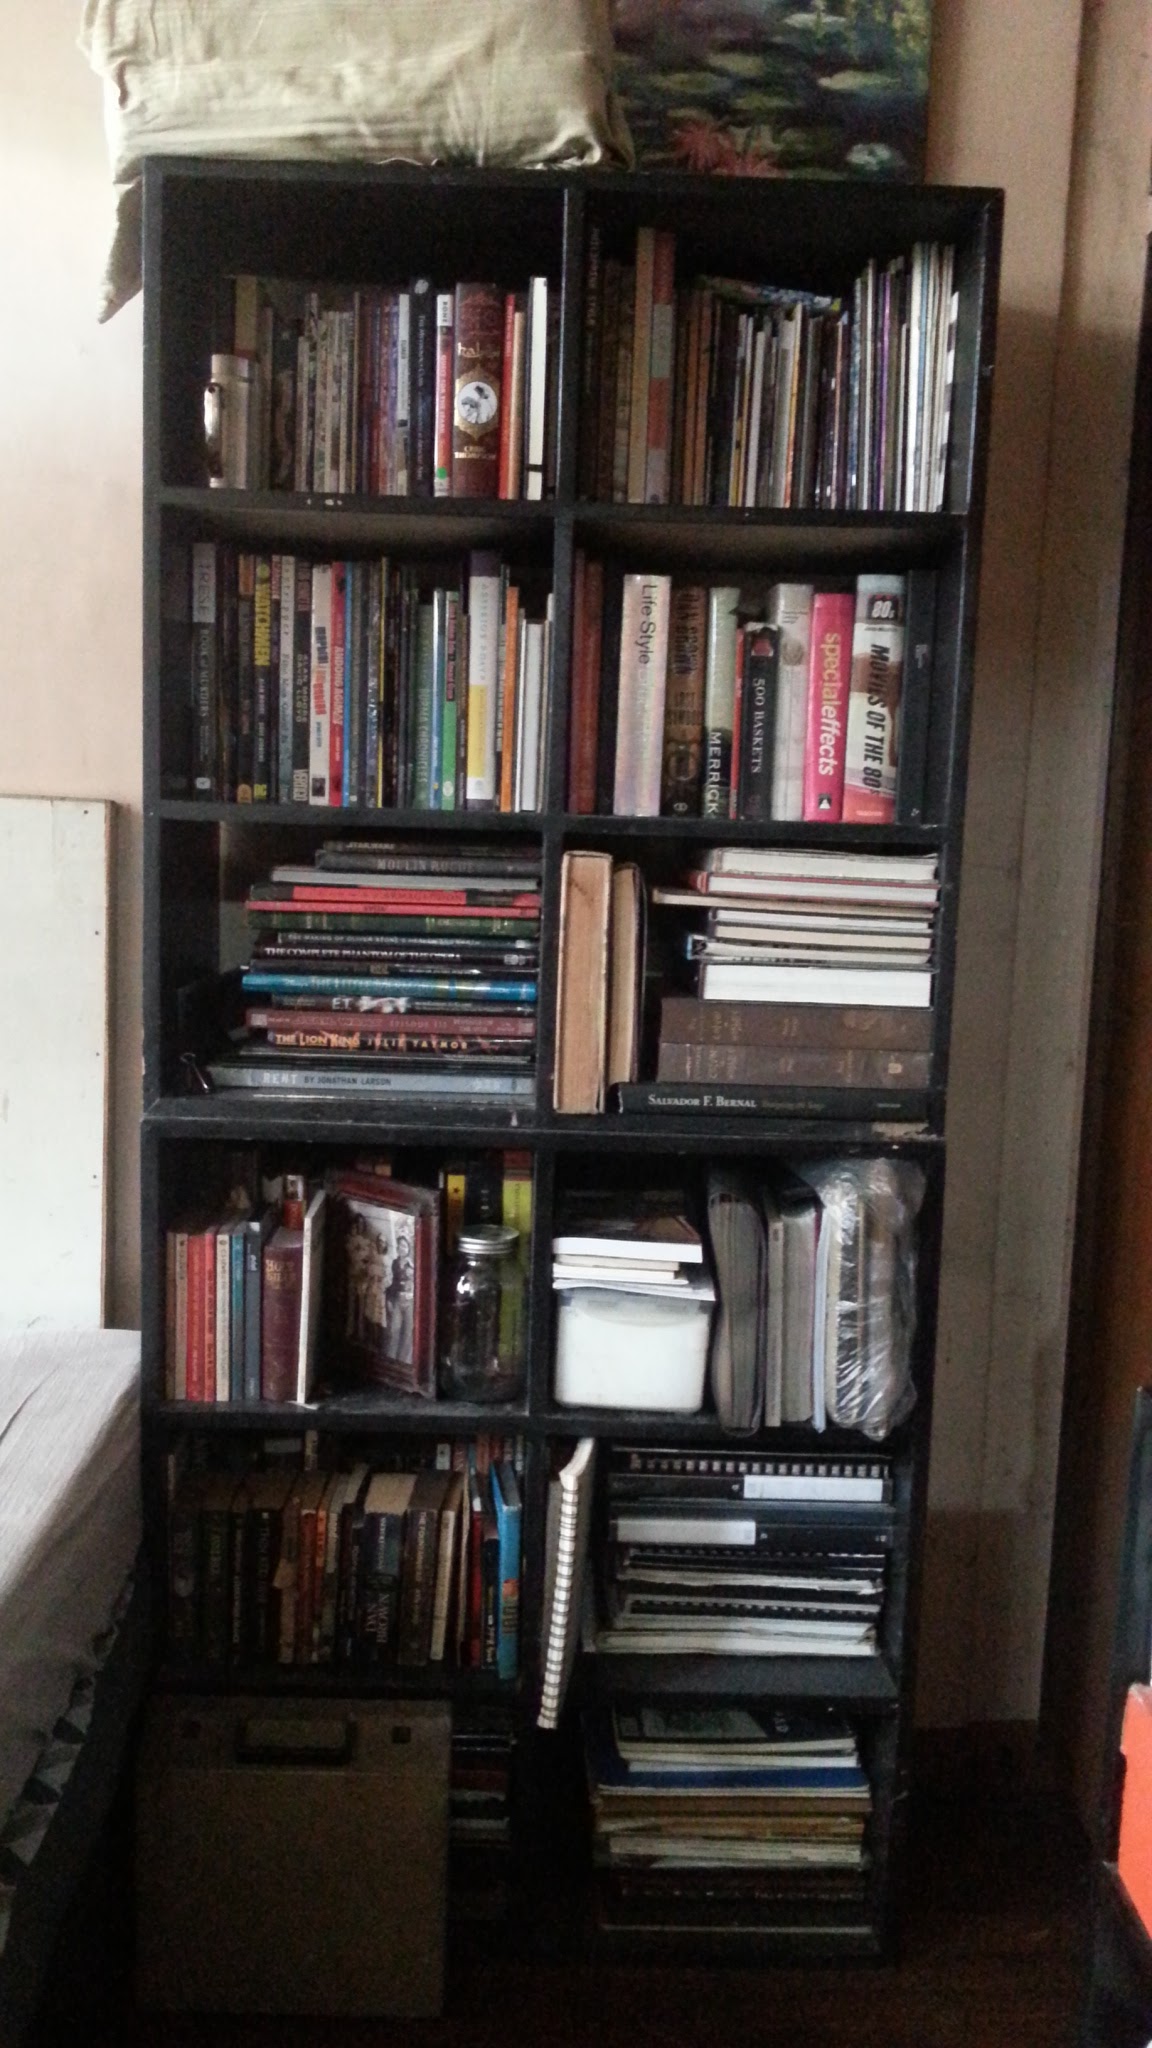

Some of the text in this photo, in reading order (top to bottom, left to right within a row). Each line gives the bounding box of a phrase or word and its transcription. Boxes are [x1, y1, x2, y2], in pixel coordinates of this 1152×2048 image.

[640, 584, 658, 617] Life
[871, 600, 896, 619] 80s
[254, 583, 271, 666] WATCHMEN
[200, 628, 210, 657] BOOK
[635, 619, 656, 665] Style
[333, 645, 344, 688] ANDONG
[867, 644, 890, 708] MOVIES
[818, 632, 842, 776] specialeffects
[751, 677, 766, 774] 500 BASKETS
[866, 711, 887, 733] OF
[417, 725, 428, 783] CHRONICLES
[864, 736, 885, 766] THE
[292, 769, 309, 802] VERTIGO
[707, 731, 722, 813] MERRICK
[377, 858, 427, 871] MOULIN
[265, 946, 287, 956] THE
[287, 947, 341, 958] COMPLETE
[342, 949, 393, 959] PHANTOM
[275, 1033, 360, 1049] THE LION KING
[367, 1037, 469, 1050] JULIE TAYMOR
[263, 1072, 391, 1086] RENT BY JONATHAN LARSON
[647, 1093, 757, 1108] SALVADOR F. BERNAL
[419, 1511, 427, 1525] THE
[376, 1593, 390, 1643] BROWN
